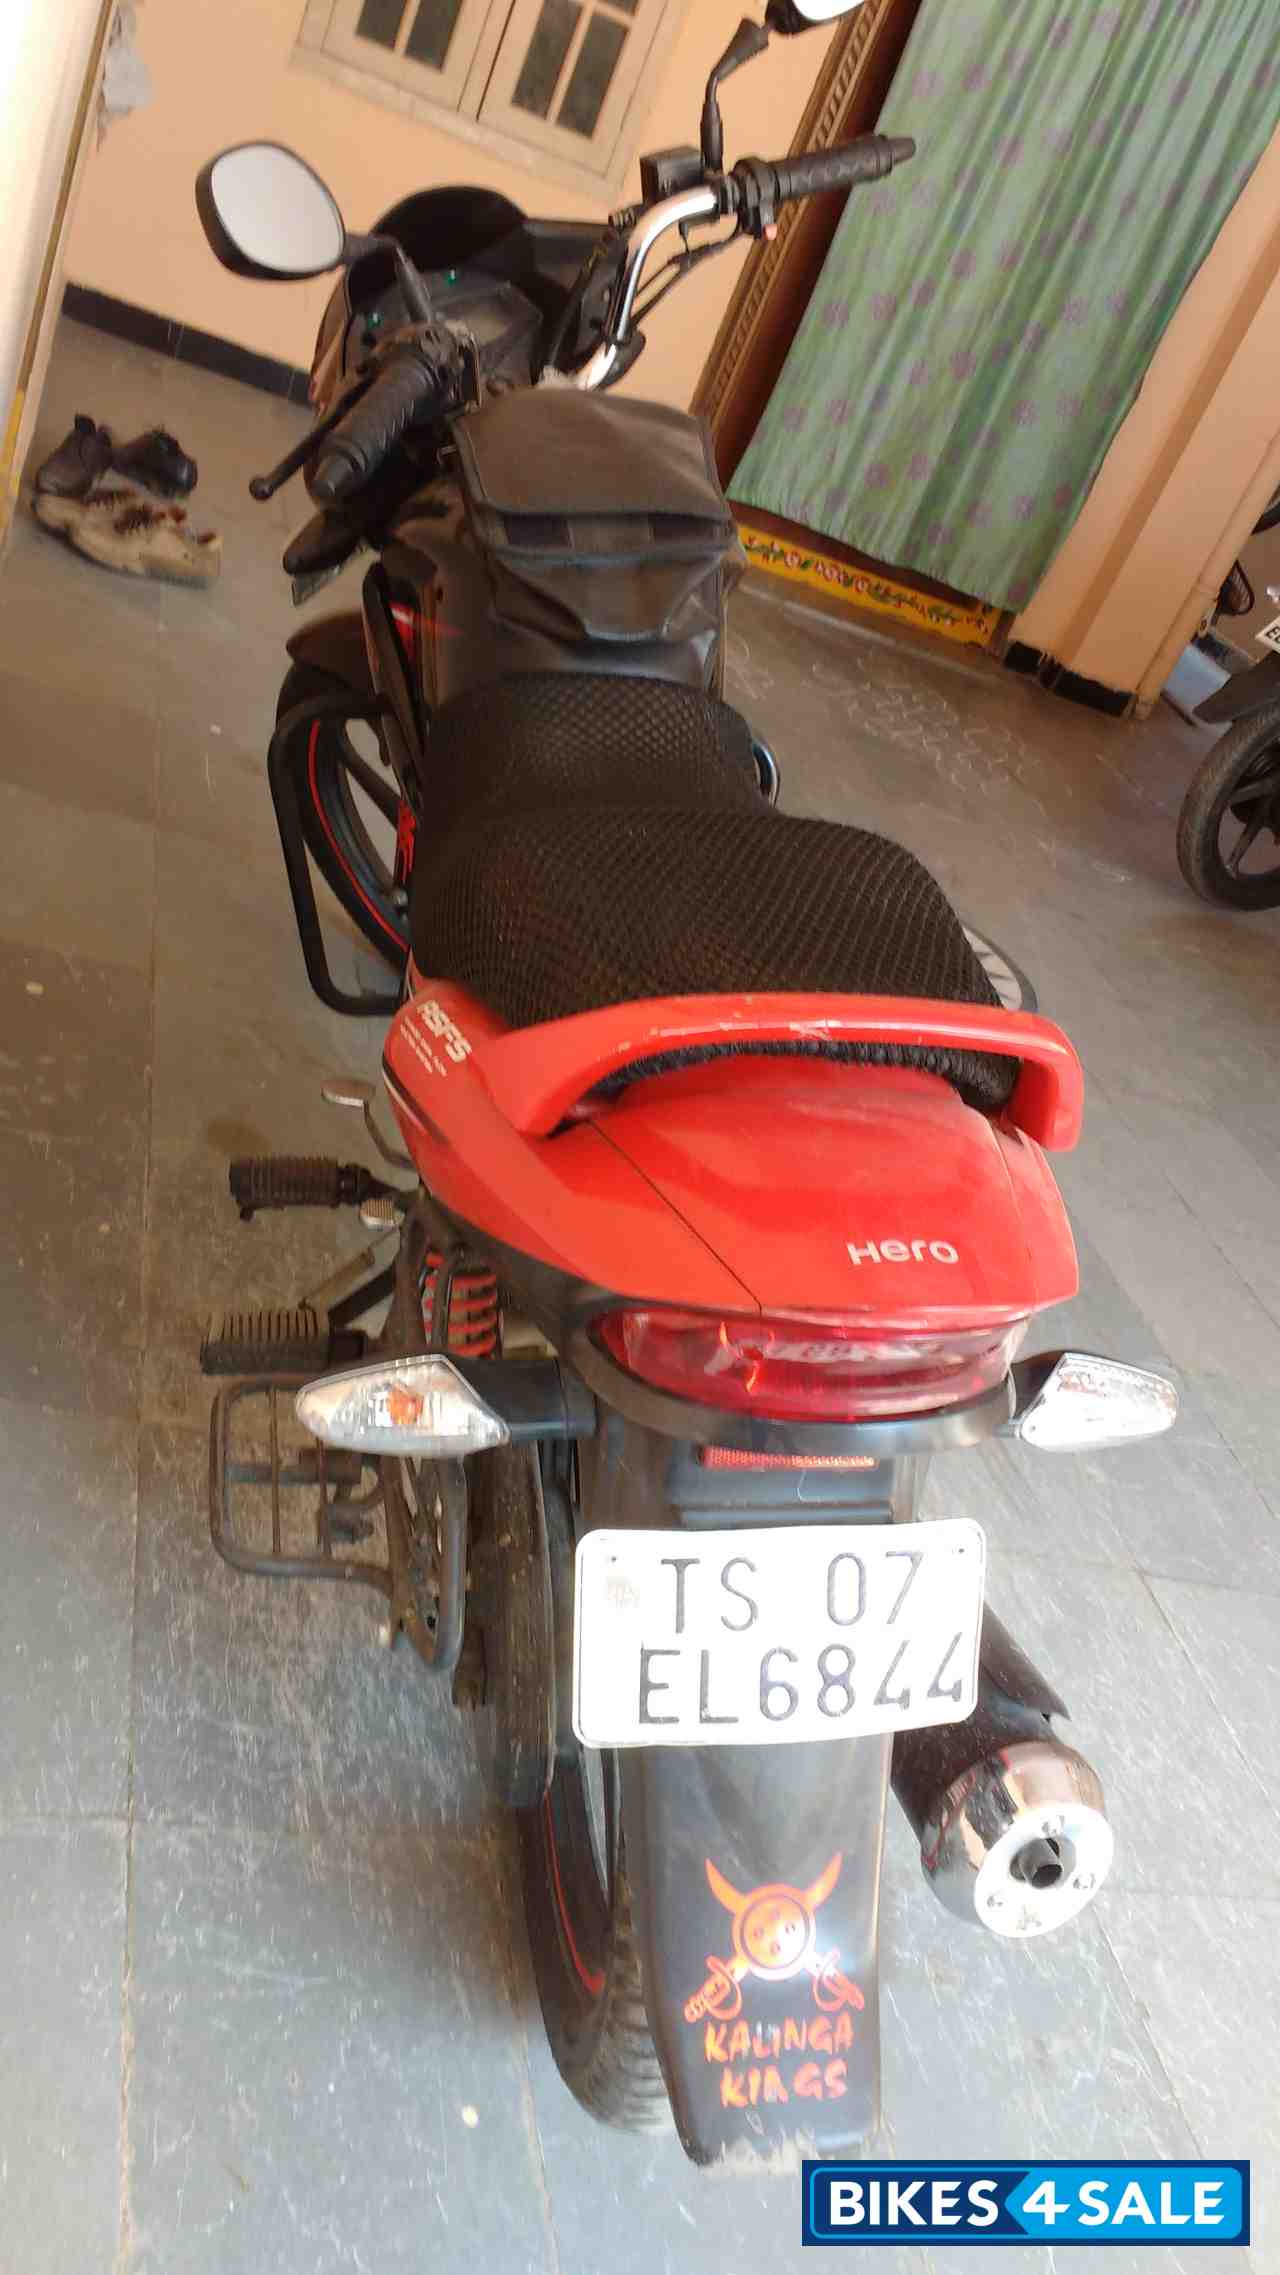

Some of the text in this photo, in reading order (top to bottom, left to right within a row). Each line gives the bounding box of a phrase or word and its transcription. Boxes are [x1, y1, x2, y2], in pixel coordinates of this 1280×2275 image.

[847, 1239, 960, 1265] Hero
[660, 1552, 924, 1633] TS 07
[638, 1632, 962, 1725] EL6844
[704, 2012, 854, 2064] KALINGA
